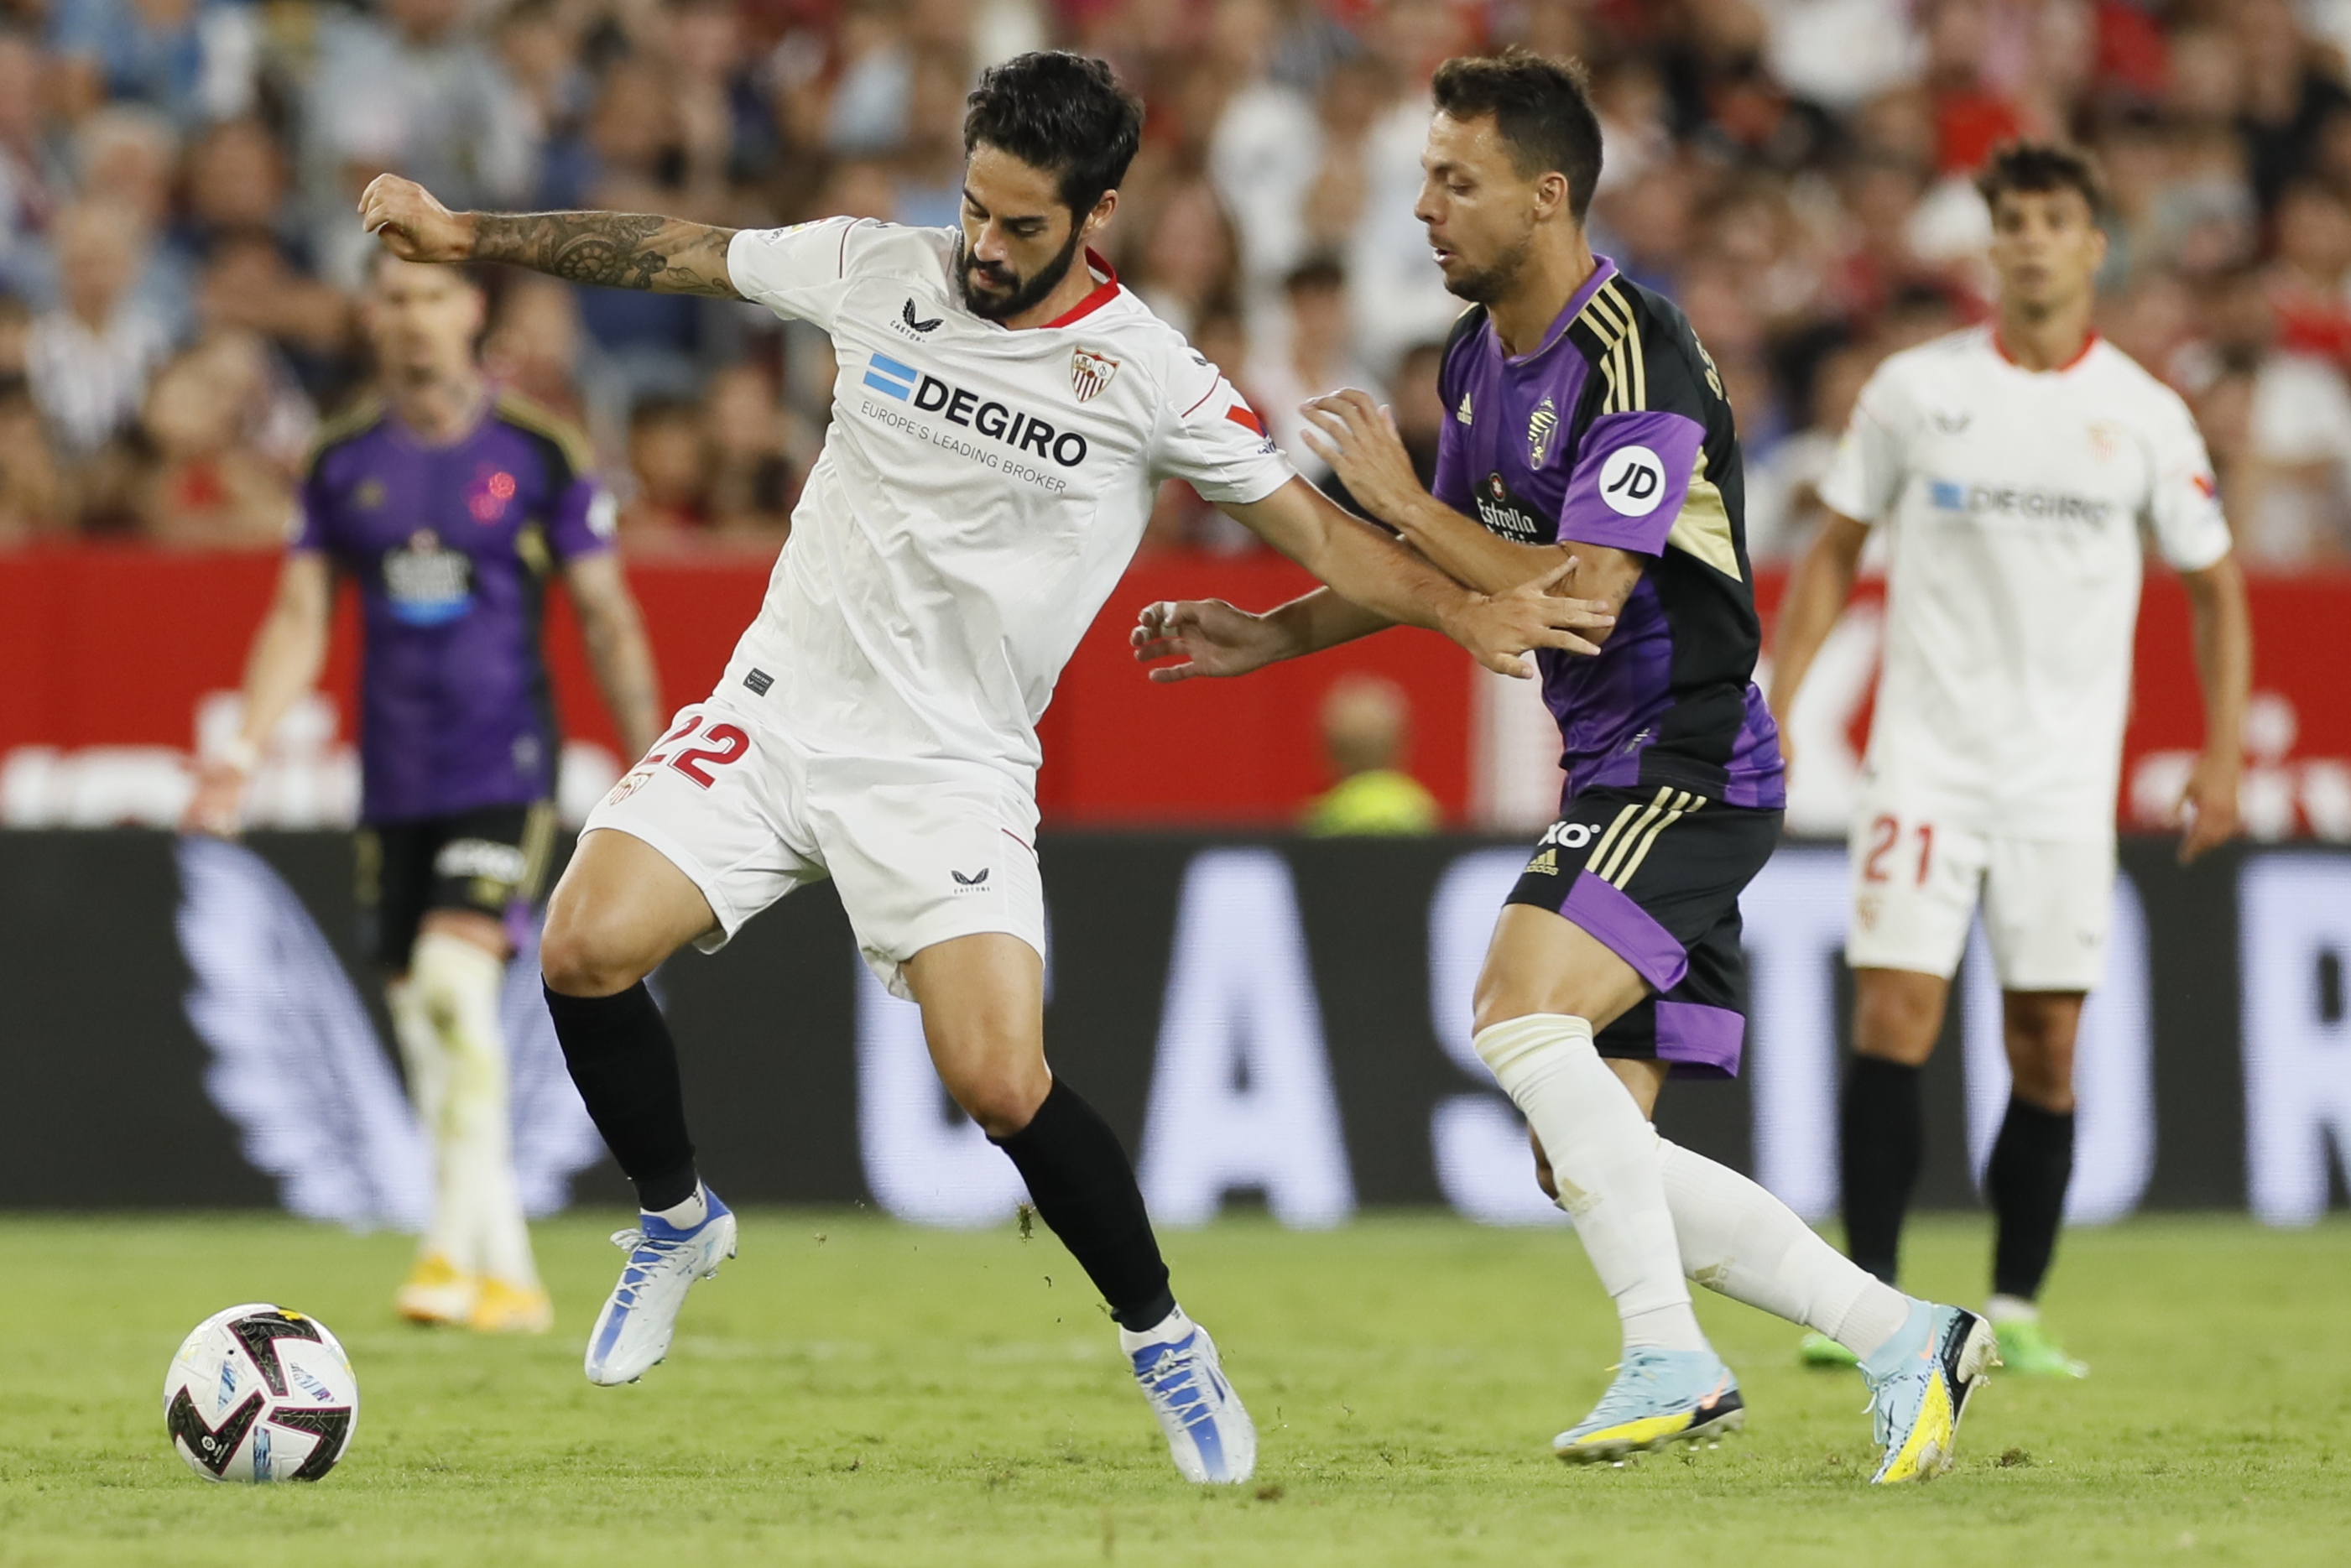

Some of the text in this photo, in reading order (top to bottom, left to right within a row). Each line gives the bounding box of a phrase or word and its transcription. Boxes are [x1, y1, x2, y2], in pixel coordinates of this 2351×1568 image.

[913, 374, 1087, 467] DEGIRO
[932, 431, 999, 468] LEADING
[1001, 460, 1067, 494] BROKER
[1607, 462, 1657, 500] JD
[1477, 497, 1538, 534] Estrella
[633, 715, 750, 791] 22
[1864, 814, 1936, 891] 21
